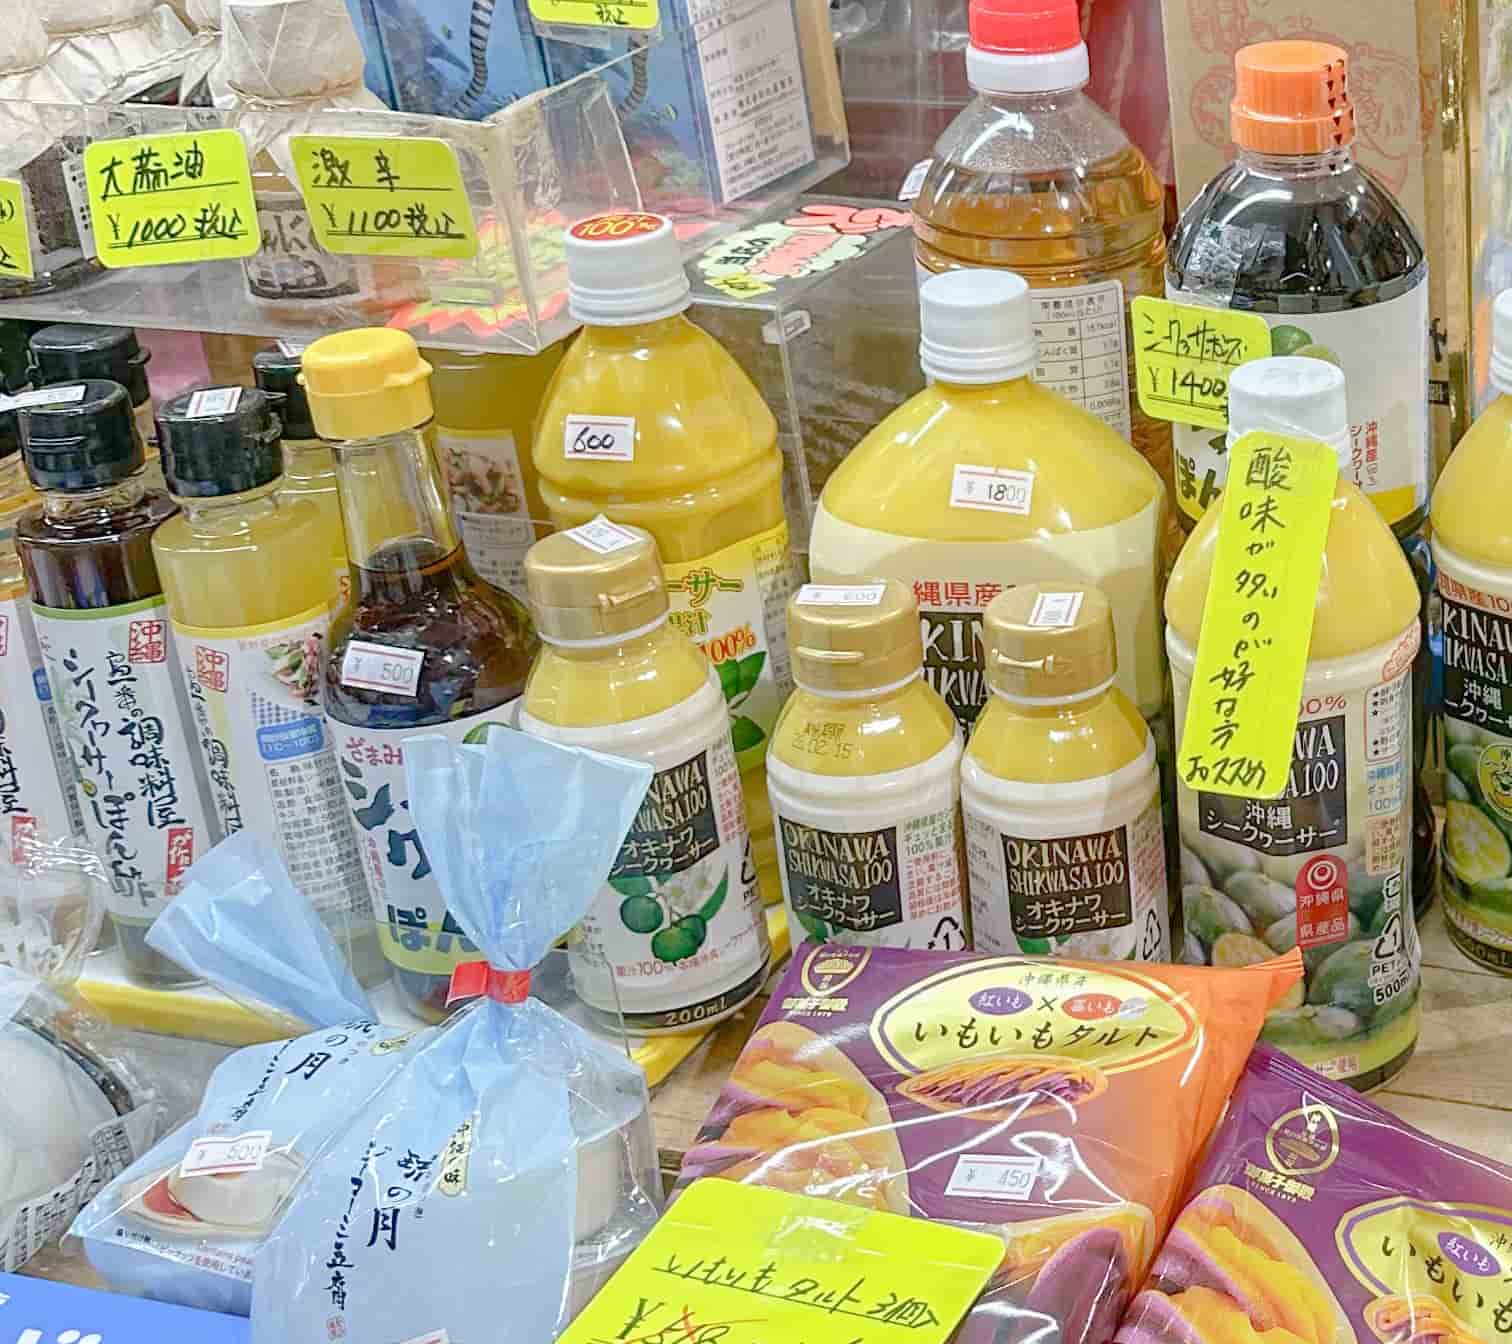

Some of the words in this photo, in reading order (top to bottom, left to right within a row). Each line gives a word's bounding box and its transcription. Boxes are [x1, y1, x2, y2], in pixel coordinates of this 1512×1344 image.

[127, 211, 187, 247] 1000
[346, 207, 402, 234] 1100
[1171, 369, 1227, 398] 1400
[572, 425, 616, 454] 600
[985, 481, 1028, 505] 1800
[381, 664, 415, 684] 500
[1463, 678, 1503, 711] 沖縄
[1245, 799, 1292, 827] 沖縄
[623, 825, 695, 858] オキナワ
[784, 820, 891, 861] OKINAWA
[1004, 831, 1126, 869] OKINAWA
[806, 882, 872, 913] オキナワ
[1025, 893, 1103, 918] オキナワ
[977, 990, 1026, 1010] 紅いも
[912, 1018, 1161, 1051] いもいもタルト
[998, 1169, 1032, 1190] 450
[1443, 1235, 1495, 1275] 紅いも
